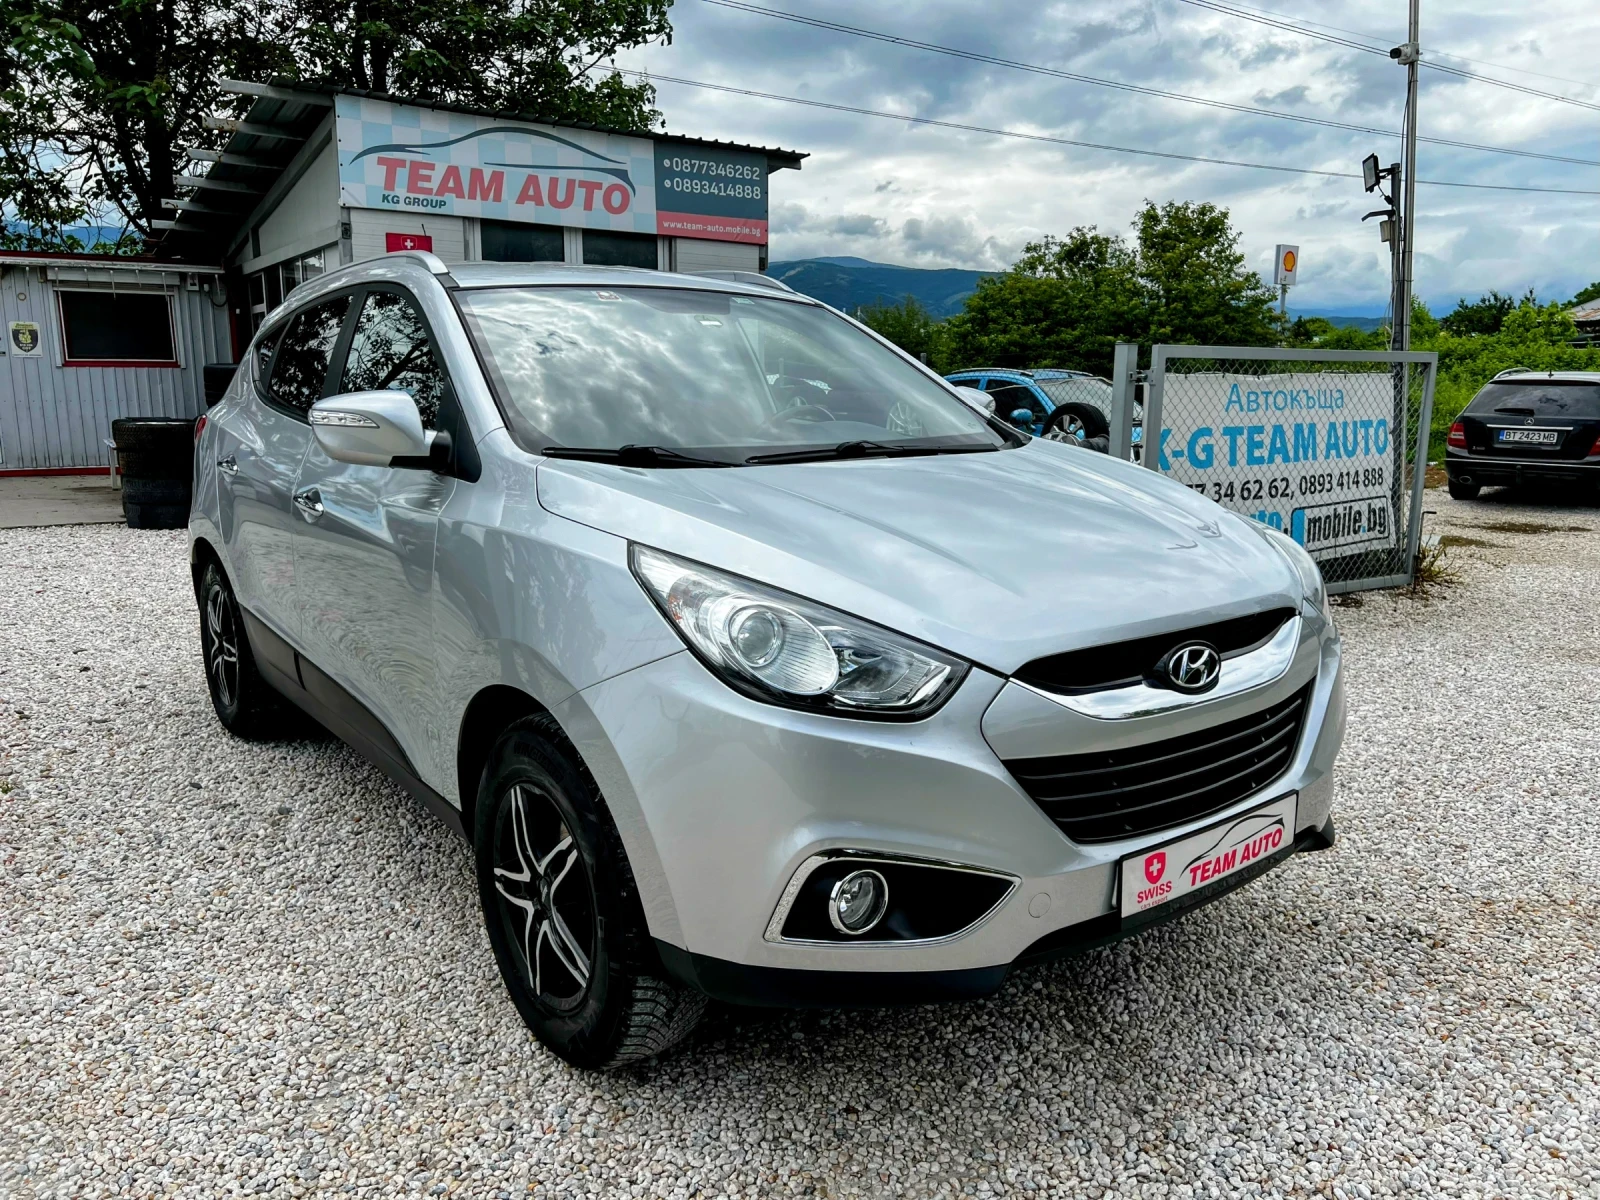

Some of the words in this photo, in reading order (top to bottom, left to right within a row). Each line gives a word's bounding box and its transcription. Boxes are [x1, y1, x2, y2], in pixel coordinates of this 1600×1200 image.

[672, 158, 760, 180] 0877346262
[377, 156, 505, 203] TEAM
[515, 174, 631, 215] AUTO
[673, 178, 761, 199] 0893414888
[381, 193, 400, 206] KG
[403, 196, 447, 209] GROUP
[663, 220, 761, 237] www.team-auto.mobile.bg
[1225, 383, 1344, 413] Автокъща
[1223, 422, 1317, 467] TEAM
[1325, 418, 1388, 460] AUTO
[1505, 431, 1517, 440] BT
[1518, 432, 1541, 440] 2423
[1542, 433, 1555, 441] MB
[1212, 481, 1235, 503] 34
[1240, 479, 1263, 500] 62
[1268, 477, 1294, 500] 62,
[1300, 473, 1333, 495] 0893
[1337, 469, 1360, 490] 414
[1363, 467, 1384, 487] 888
[1307, 502, 1387, 543] mobile.bg
[1189, 849, 1238, 886] TEAM
[1240, 828, 1283, 865] AUTO
[1137, 880, 1172, 904] SWISS
